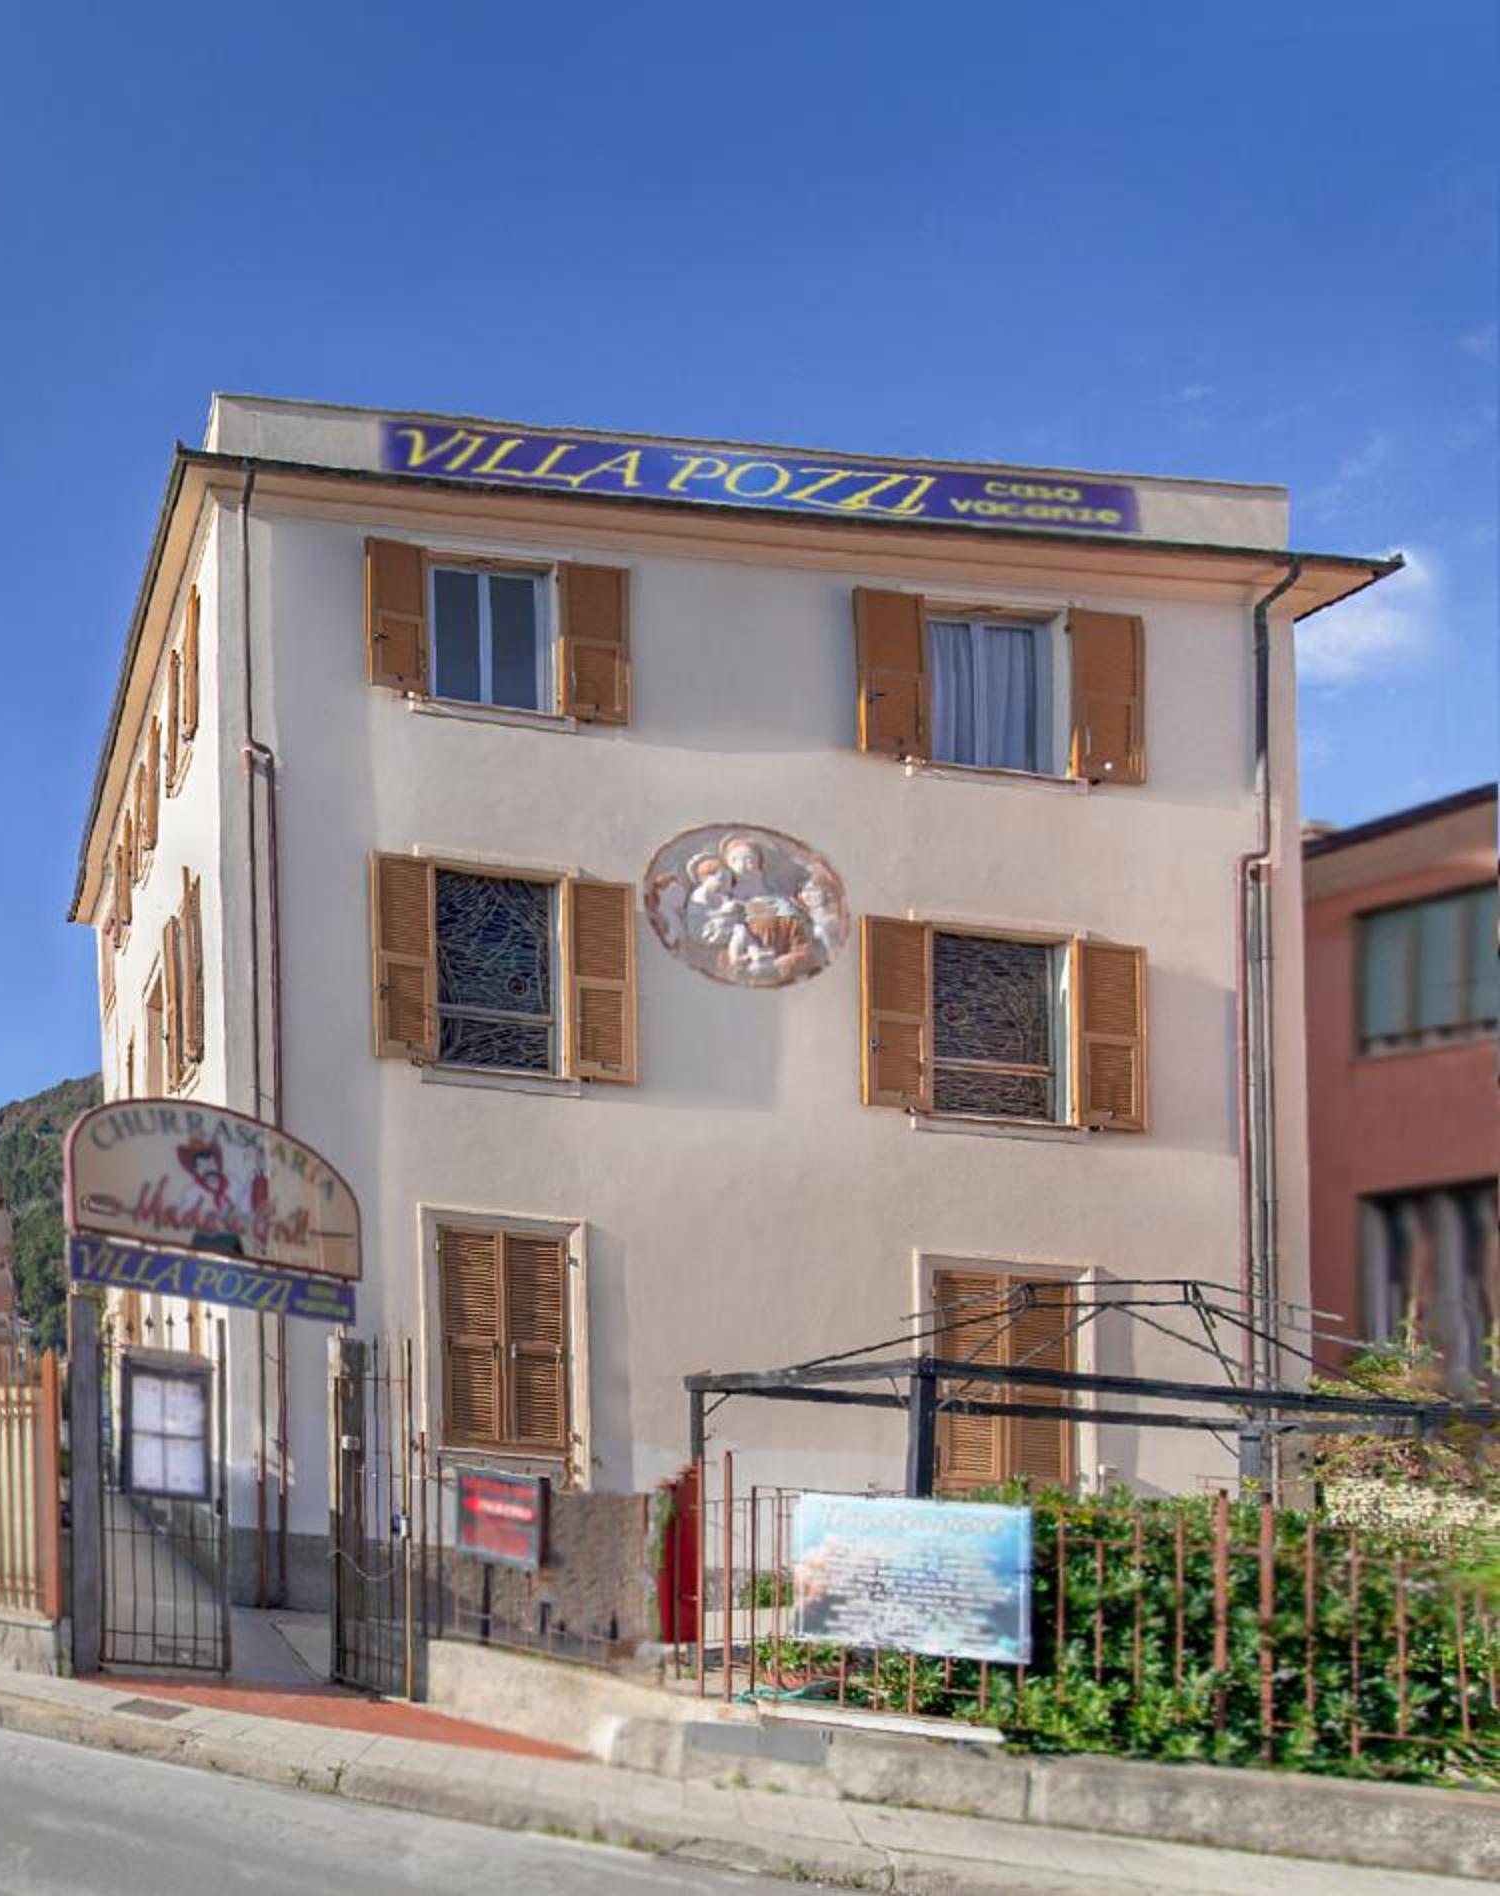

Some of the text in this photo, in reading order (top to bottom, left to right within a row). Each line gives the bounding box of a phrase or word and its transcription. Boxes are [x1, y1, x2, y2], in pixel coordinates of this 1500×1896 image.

[398, 428, 936, 516] VILLA POZZI
[984, 480, 1082, 502] casa
[949, 496, 1122, 526] vacanze
[77, 1244, 183, 1286] VILLA
[195, 1265, 293, 1313] POZZI
